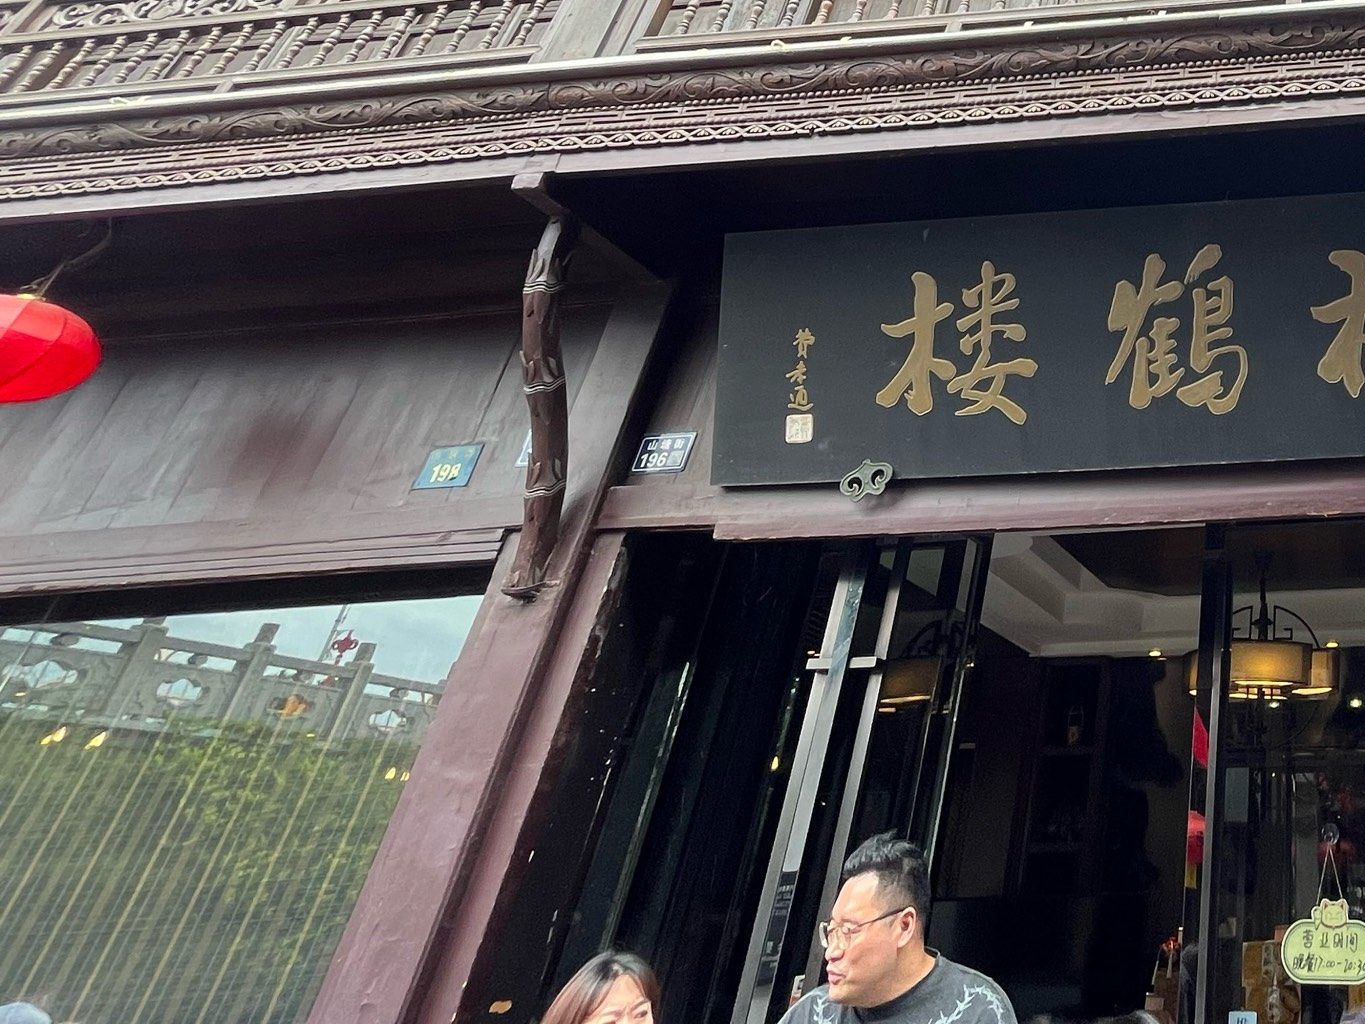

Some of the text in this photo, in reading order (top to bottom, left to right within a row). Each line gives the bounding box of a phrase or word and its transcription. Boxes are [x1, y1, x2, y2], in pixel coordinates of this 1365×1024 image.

[640, 452, 669, 468] 196
[1302, 929, 1358, 953] 营业时间
